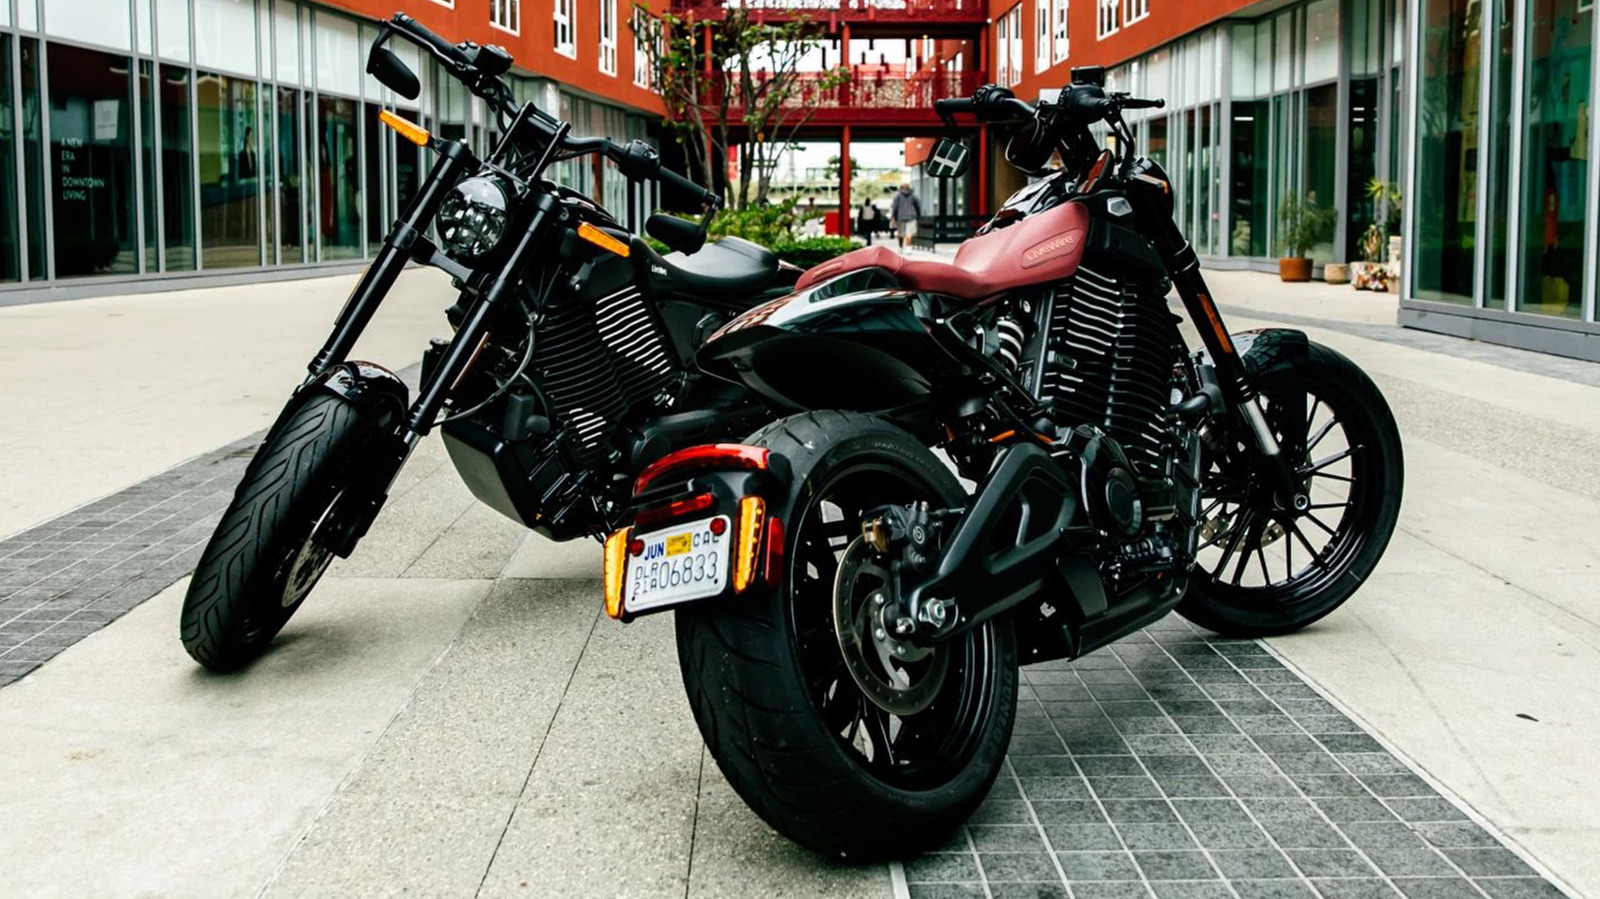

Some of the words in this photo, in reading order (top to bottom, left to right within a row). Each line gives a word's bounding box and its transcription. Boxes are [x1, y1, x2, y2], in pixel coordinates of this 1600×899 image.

[67, 137, 83, 147] NEW
[62, 150, 75, 160] ERA
[62, 164, 70, 173] IN
[63, 177, 105, 188] DOWNTOWN
[63, 190, 86, 200] LIVING
[1026, 236, 1074, 260] LiveWire
[644, 541, 664, 560] JUN
[635, 562, 659, 580] DLR
[659, 551, 718, 589] 06833
